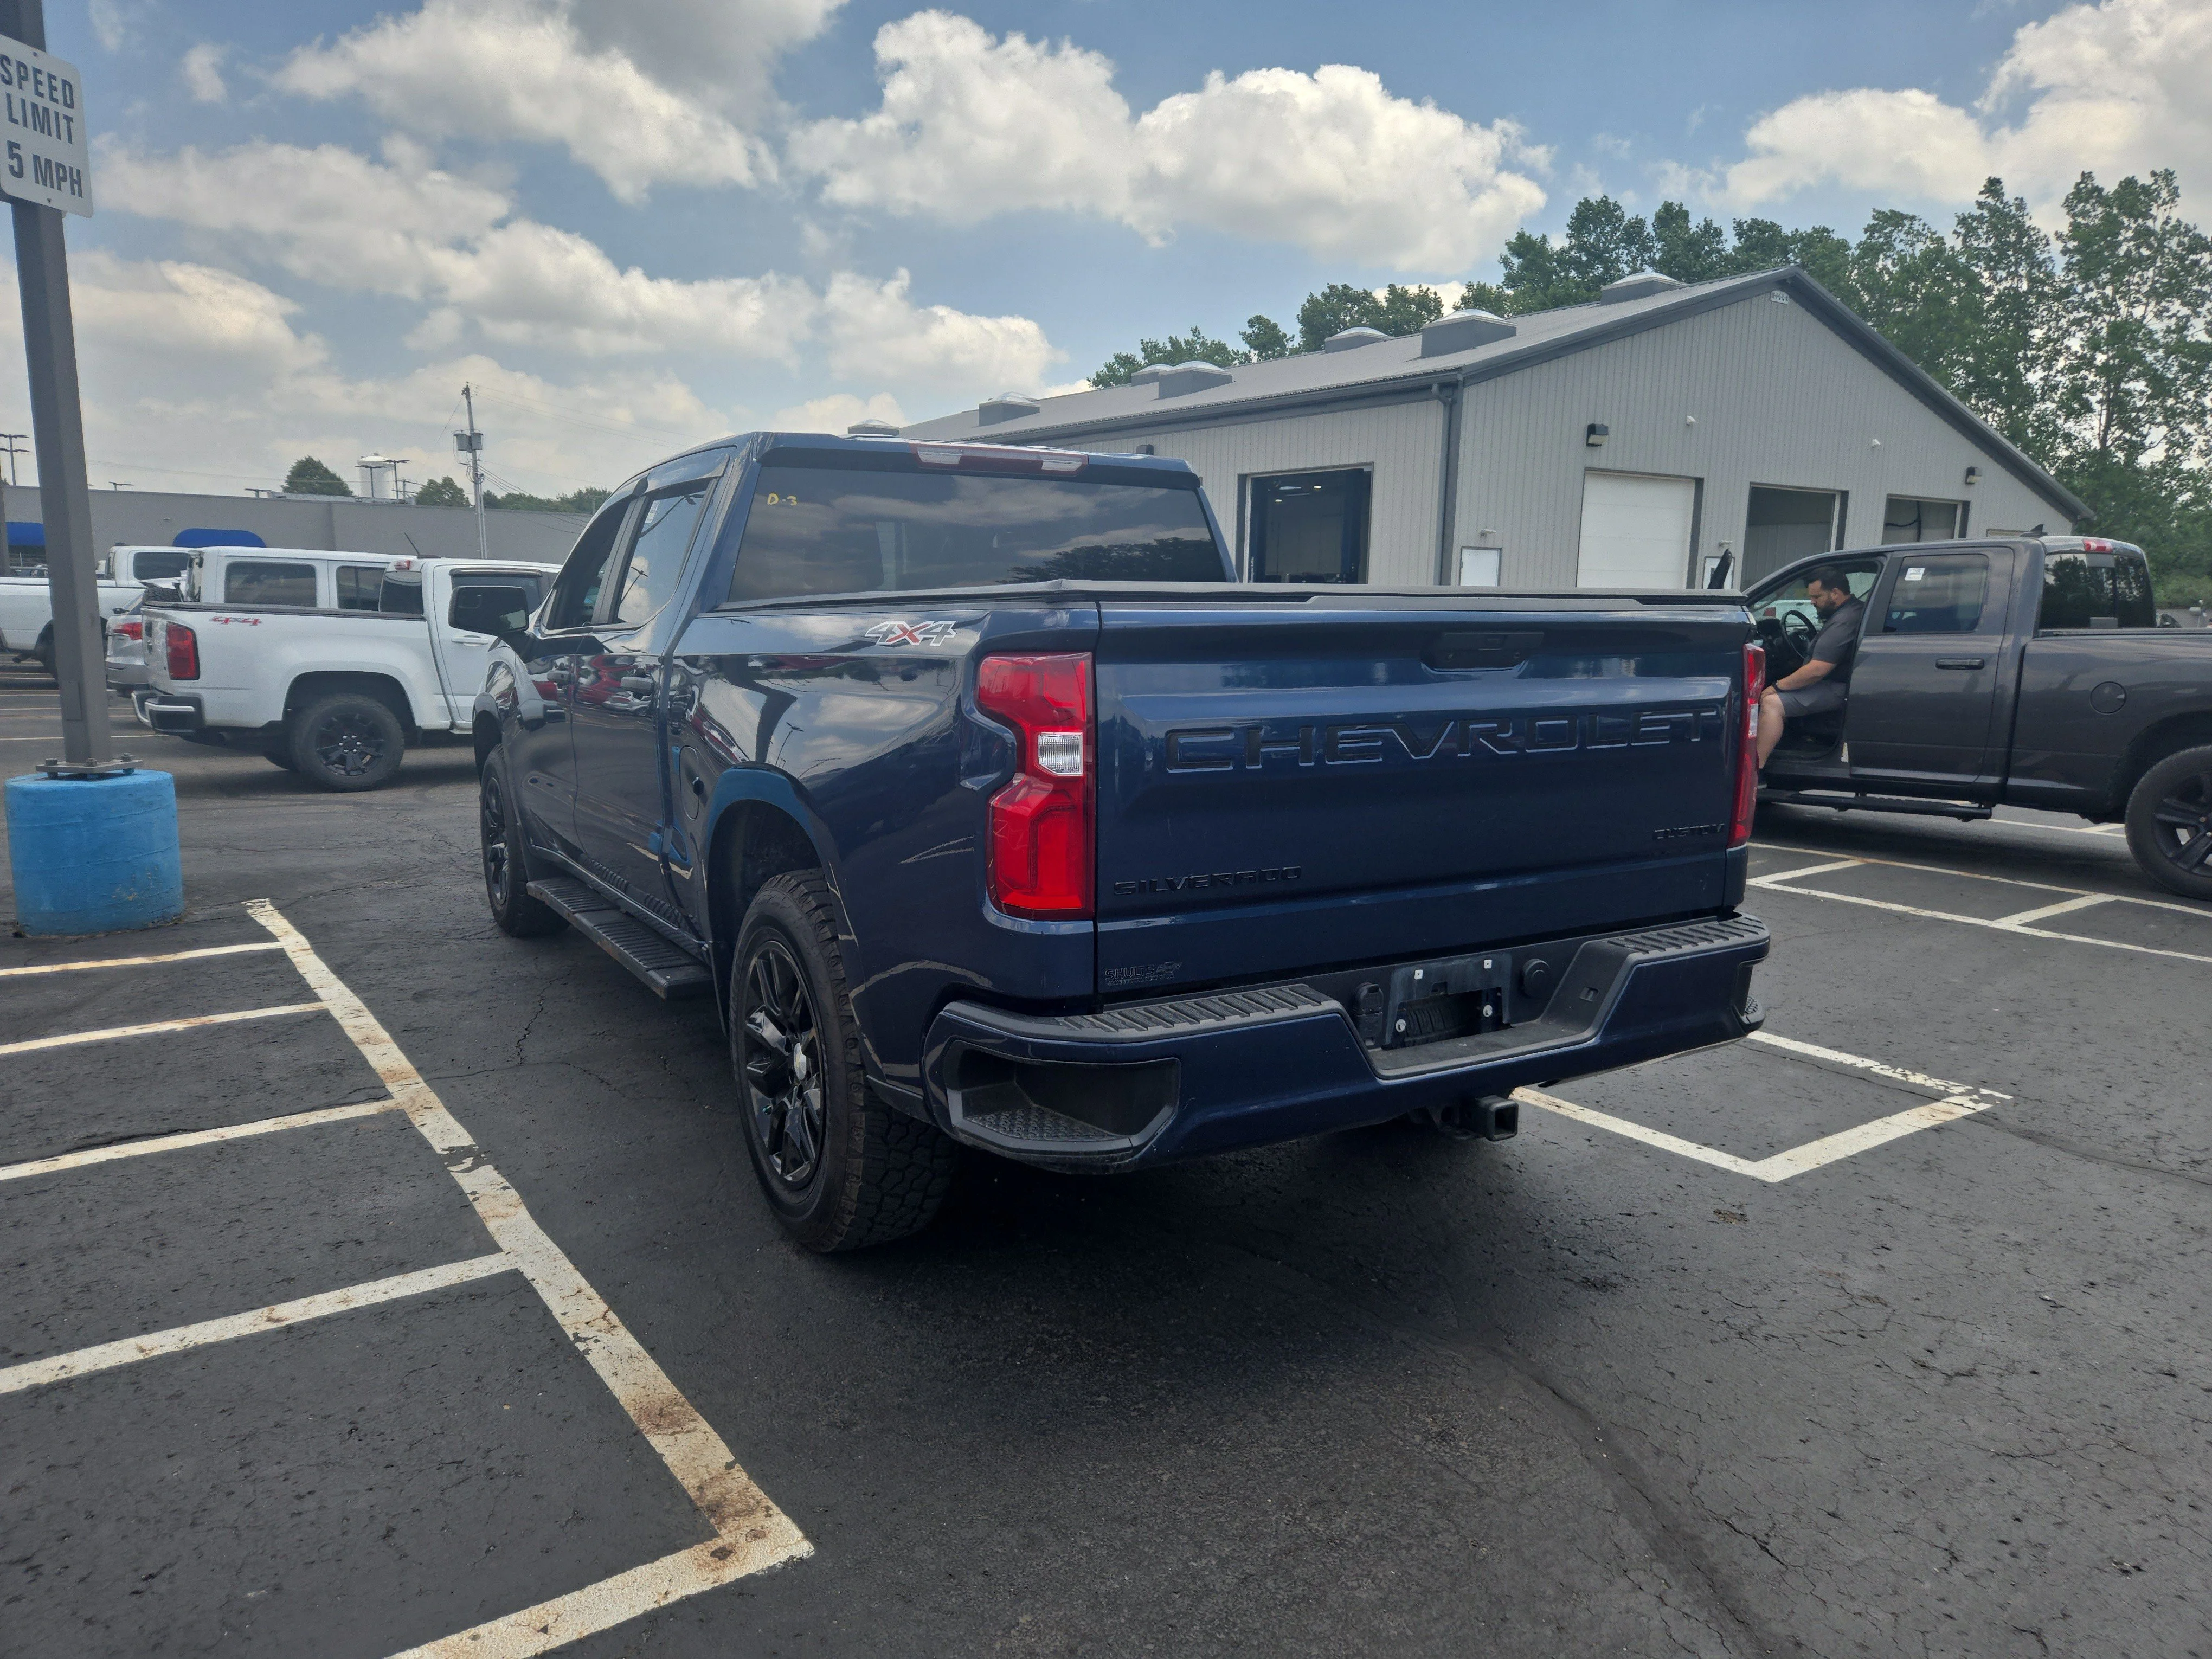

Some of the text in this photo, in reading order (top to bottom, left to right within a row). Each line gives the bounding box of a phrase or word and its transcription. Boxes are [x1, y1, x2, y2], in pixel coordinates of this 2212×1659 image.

[0, 55, 74, 109] SPEED
[6, 93, 74, 145] LIMIT
[7, 140, 83, 198] 5 MPH
[1166, 709, 1718, 773] CHEVROLET
[1114, 866, 1301, 895] SILVERADO
[1105, 964, 1155, 981] SHULTS
